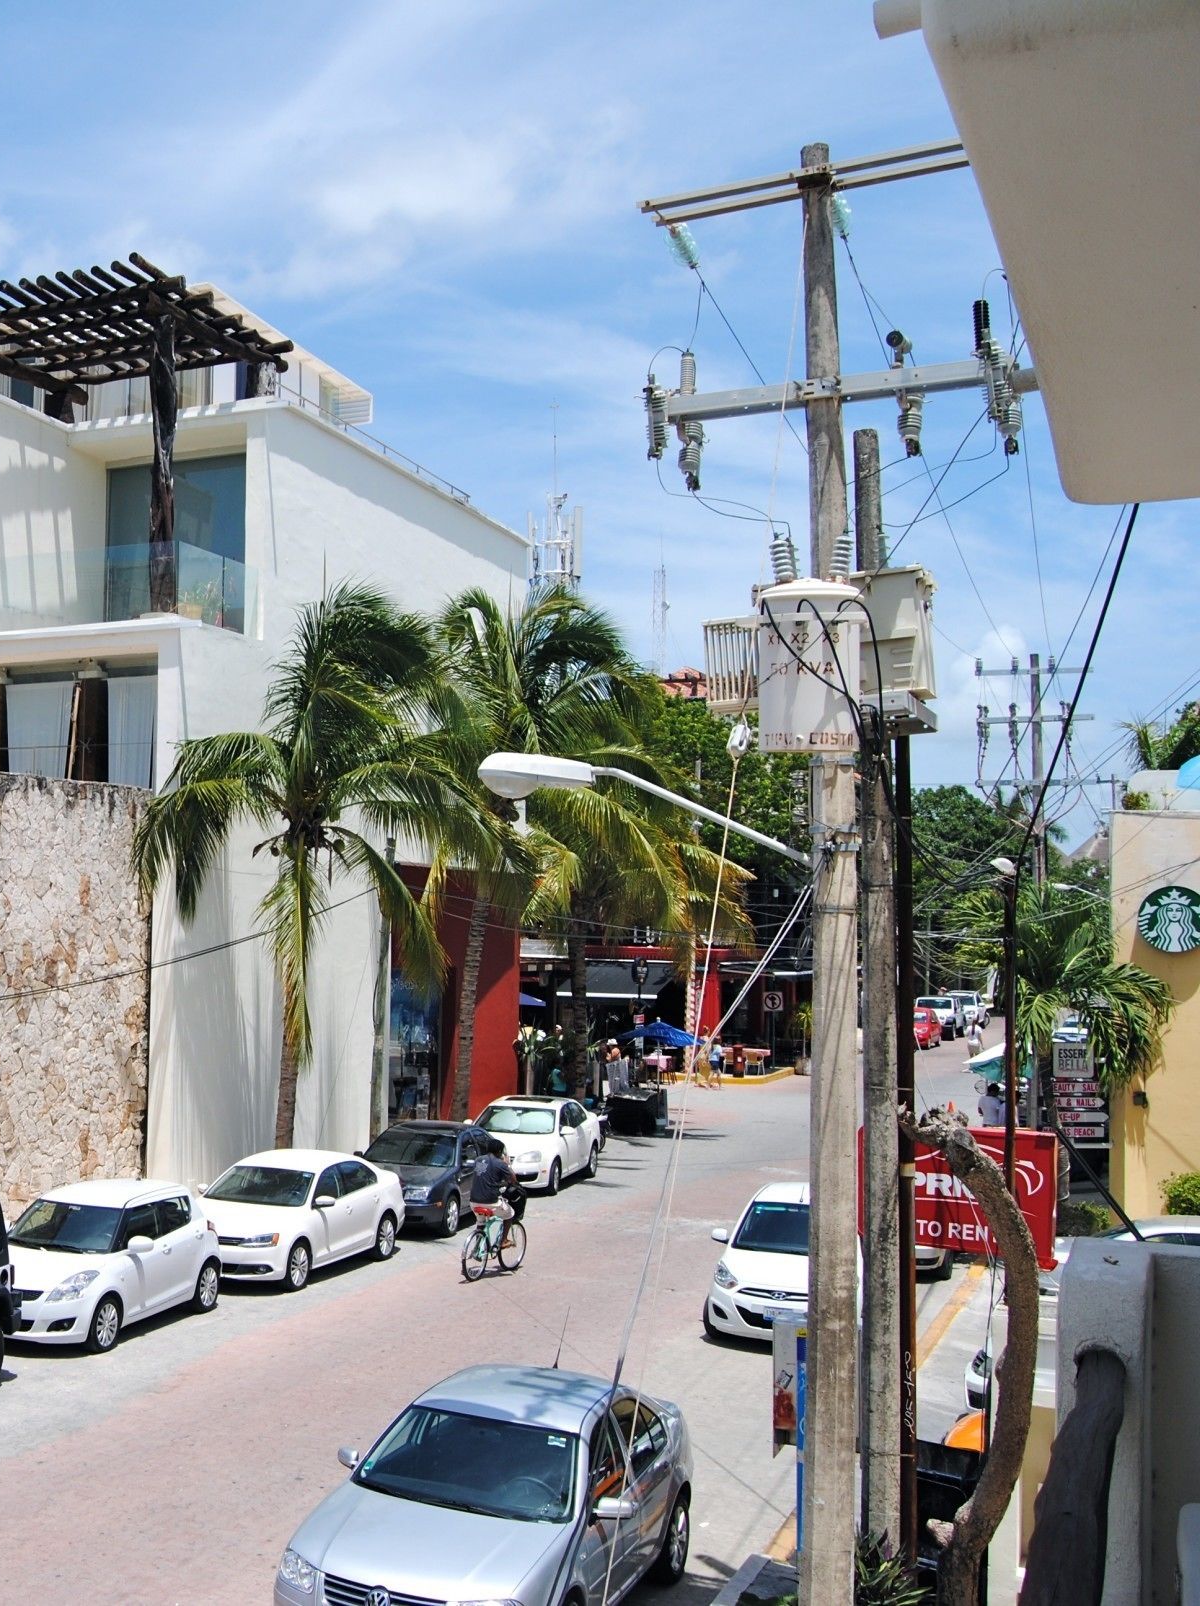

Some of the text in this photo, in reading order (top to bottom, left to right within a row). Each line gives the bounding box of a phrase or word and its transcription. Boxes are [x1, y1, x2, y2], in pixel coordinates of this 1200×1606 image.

[790, 632, 811, 644] X2
[796, 661, 835, 675] KVA
[1058, 1113, 1081, 1121] KE-UP
[1073, 1128, 1096, 1136] BEACH
[948, 1222, 997, 1242] REN
